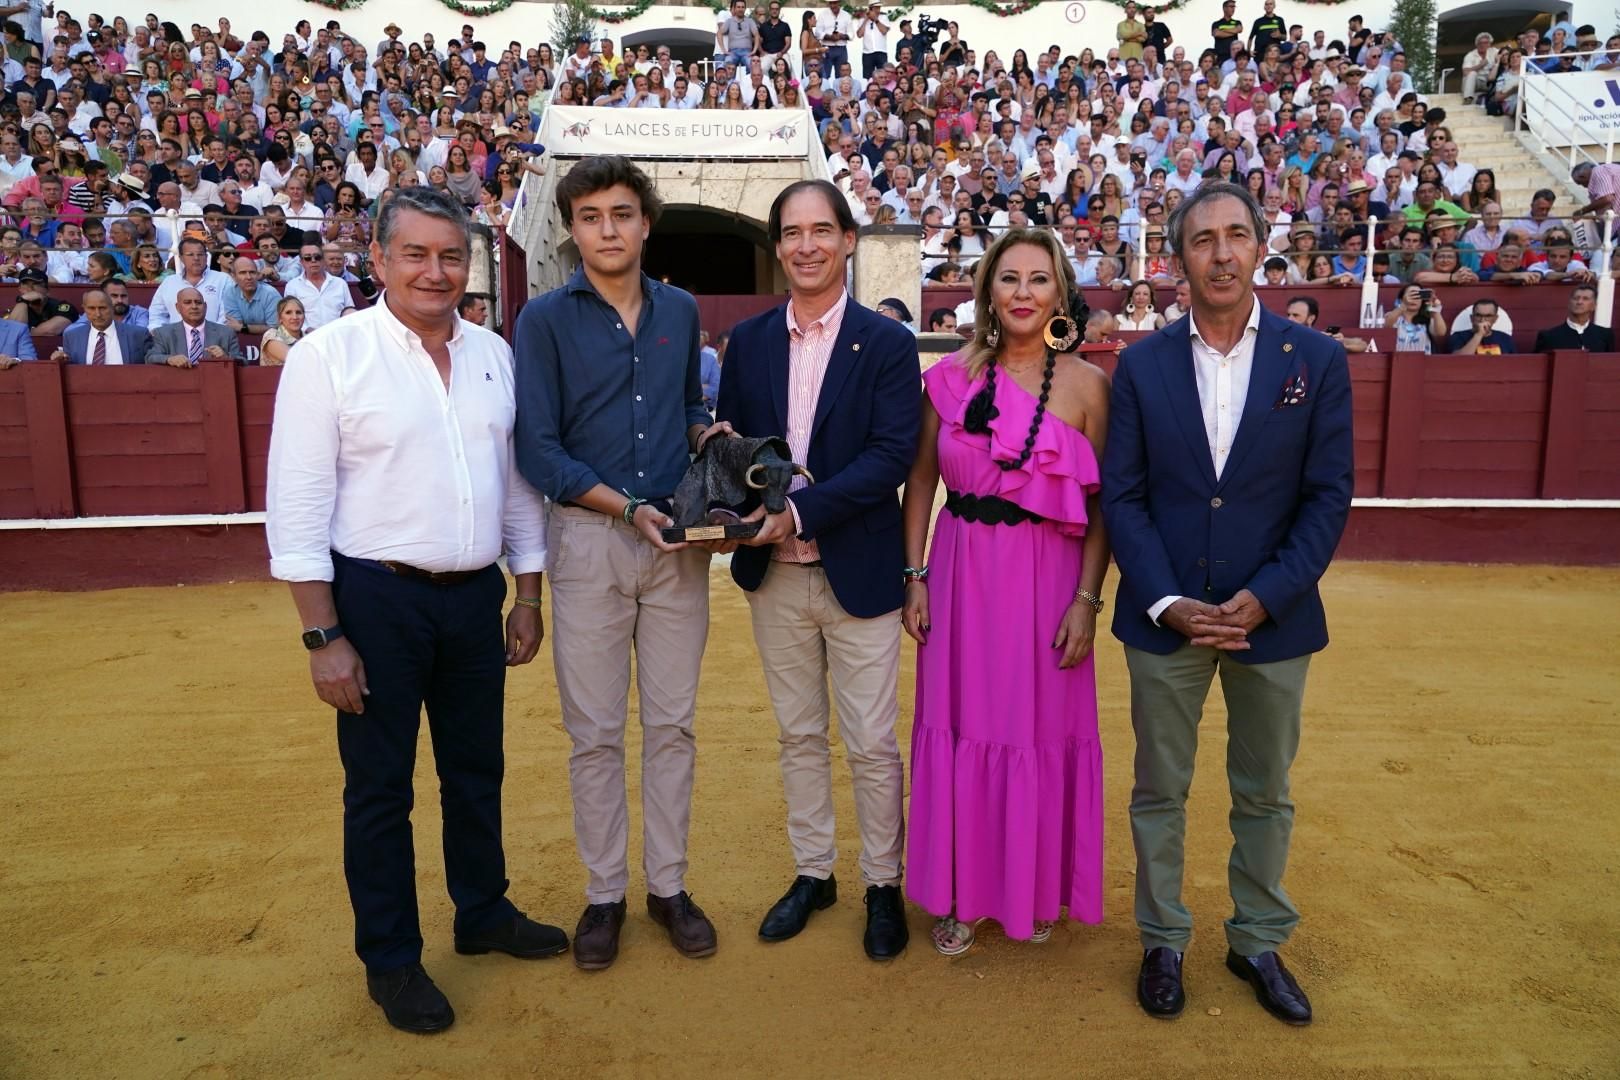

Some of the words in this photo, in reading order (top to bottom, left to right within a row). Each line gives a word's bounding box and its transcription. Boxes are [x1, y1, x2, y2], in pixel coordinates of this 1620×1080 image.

[1072, 7, 1077, 17] 1
[604, 122, 671, 137] LANCES
[674, 126, 687, 137] DE
[692, 123, 759, 138] FUTURO
